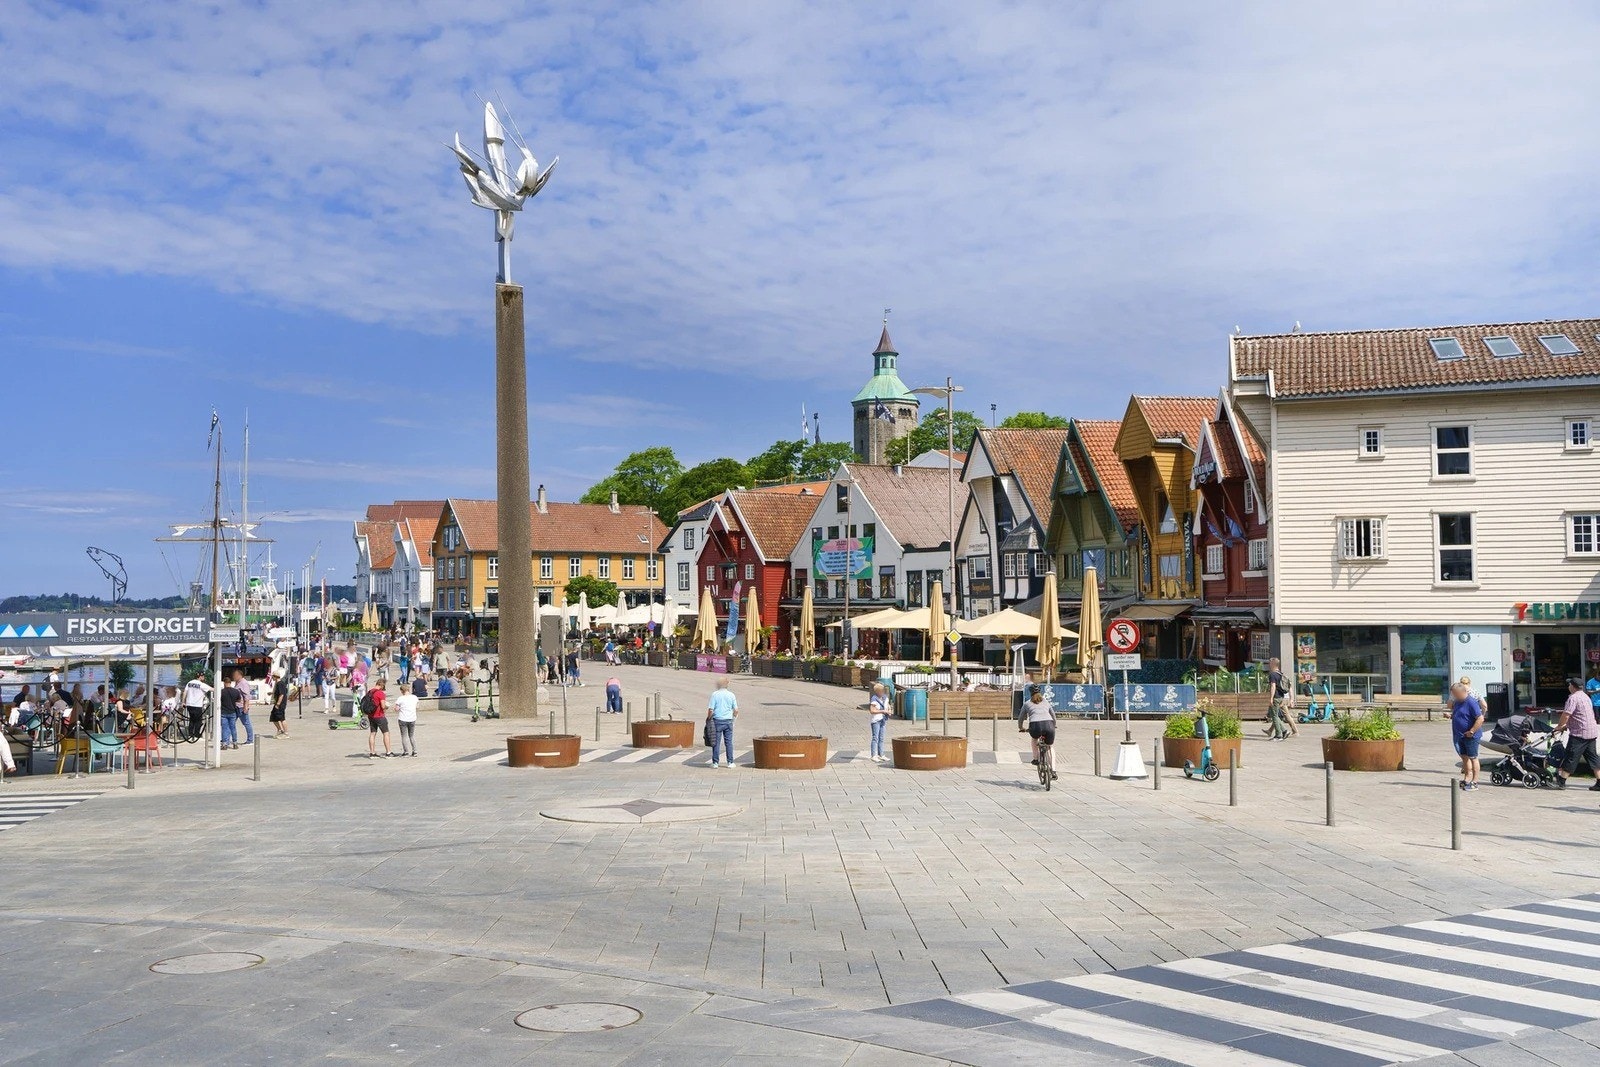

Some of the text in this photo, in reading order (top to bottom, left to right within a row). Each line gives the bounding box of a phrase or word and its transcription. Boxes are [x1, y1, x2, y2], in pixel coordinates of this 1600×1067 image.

[67, 617, 205, 634] FISKETORGET
[67, 635, 126, 643] RESTAURANT
[137, 634, 205, 642] SJØMATUTSALG
